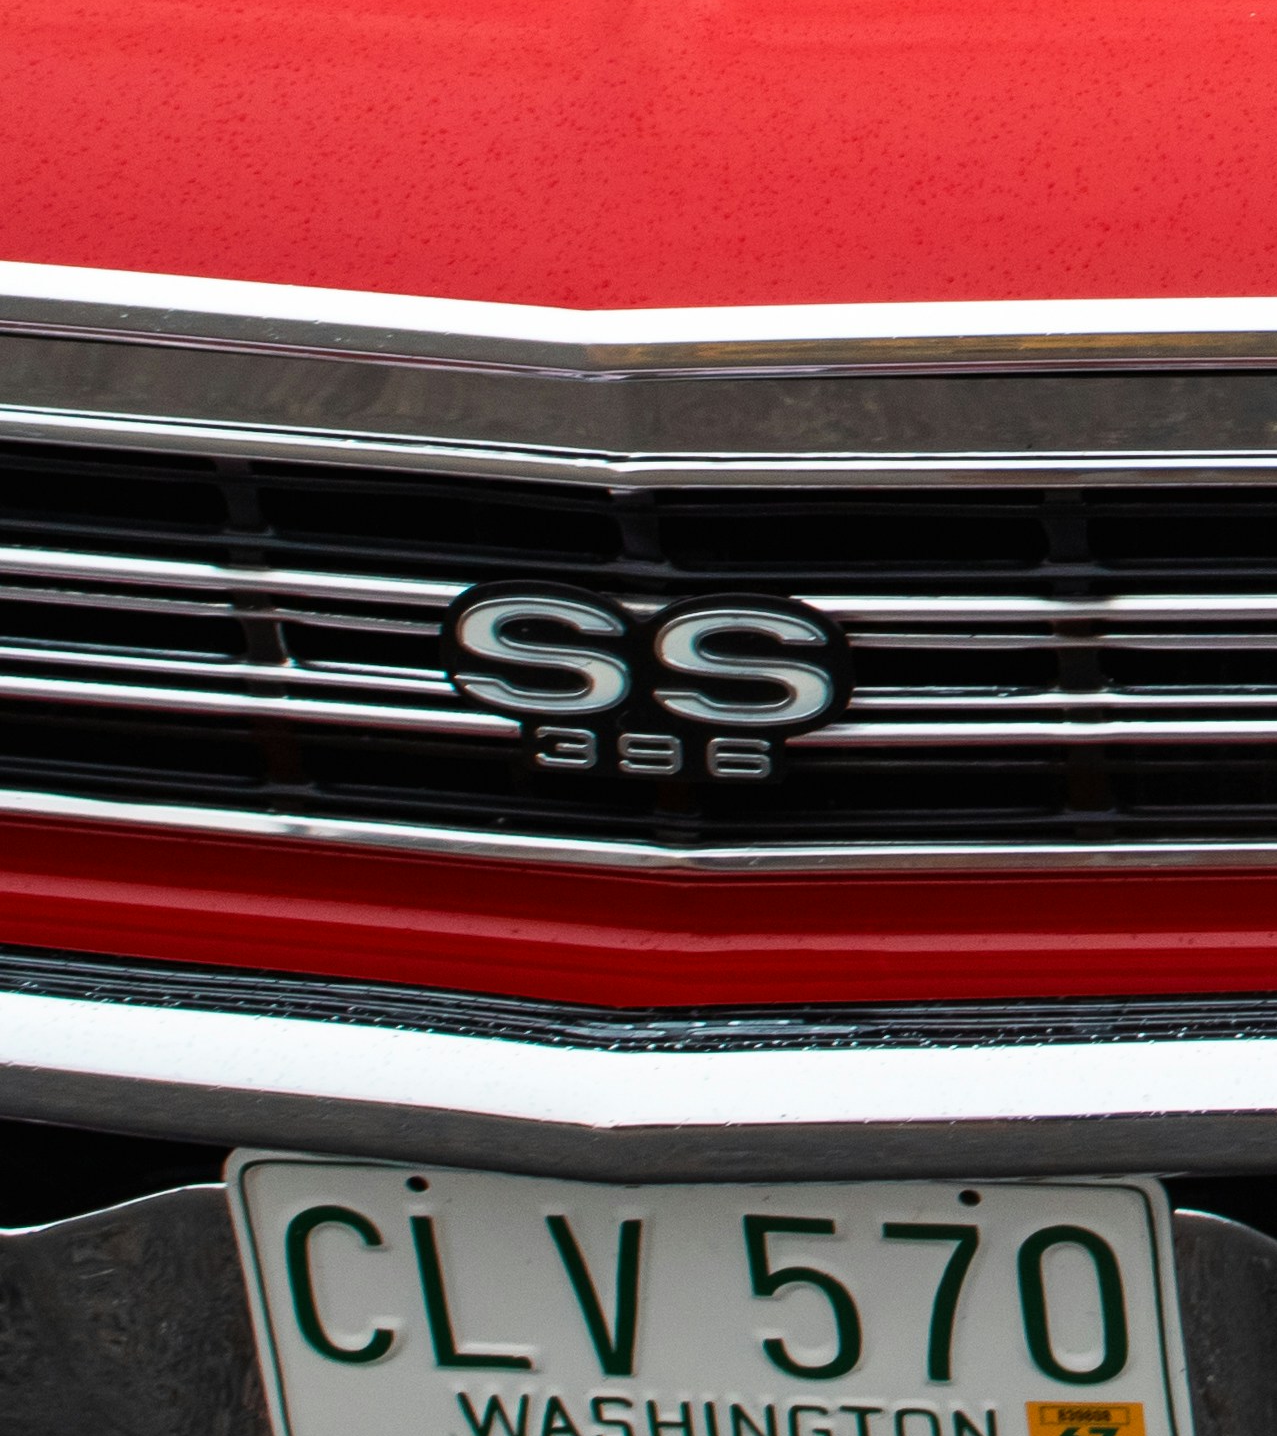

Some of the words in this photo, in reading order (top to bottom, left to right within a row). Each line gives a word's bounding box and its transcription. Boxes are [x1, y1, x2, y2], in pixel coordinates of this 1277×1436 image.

[454, 595, 835, 727] SS
[534, 725, 772, 779] 396
[283, 1204, 644, 1376] CLV
[741, 1212, 1130, 1384] 570
